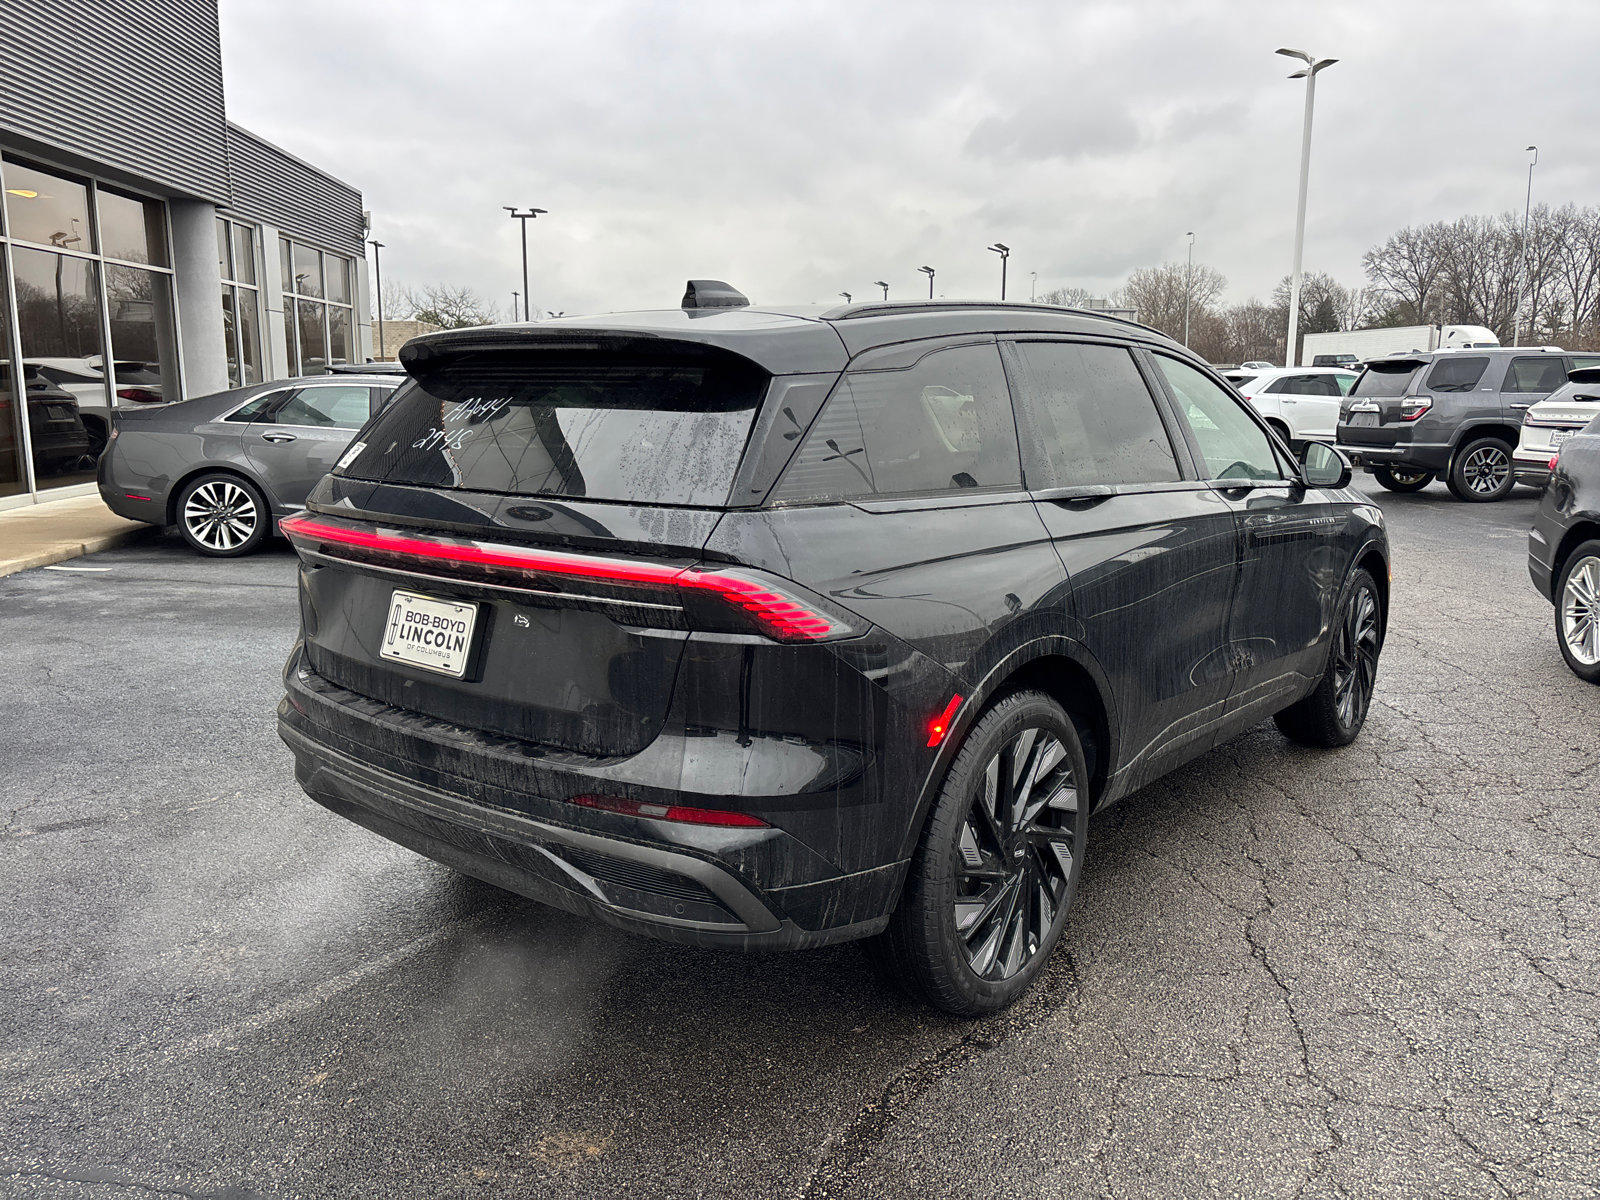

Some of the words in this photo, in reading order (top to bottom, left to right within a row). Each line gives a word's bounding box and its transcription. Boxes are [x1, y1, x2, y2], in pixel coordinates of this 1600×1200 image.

[405, 611, 466, 634] BOB-BOYD
[400, 624, 465, 652] LINCOLN
[416, 646, 451, 659] COLUMBUS
